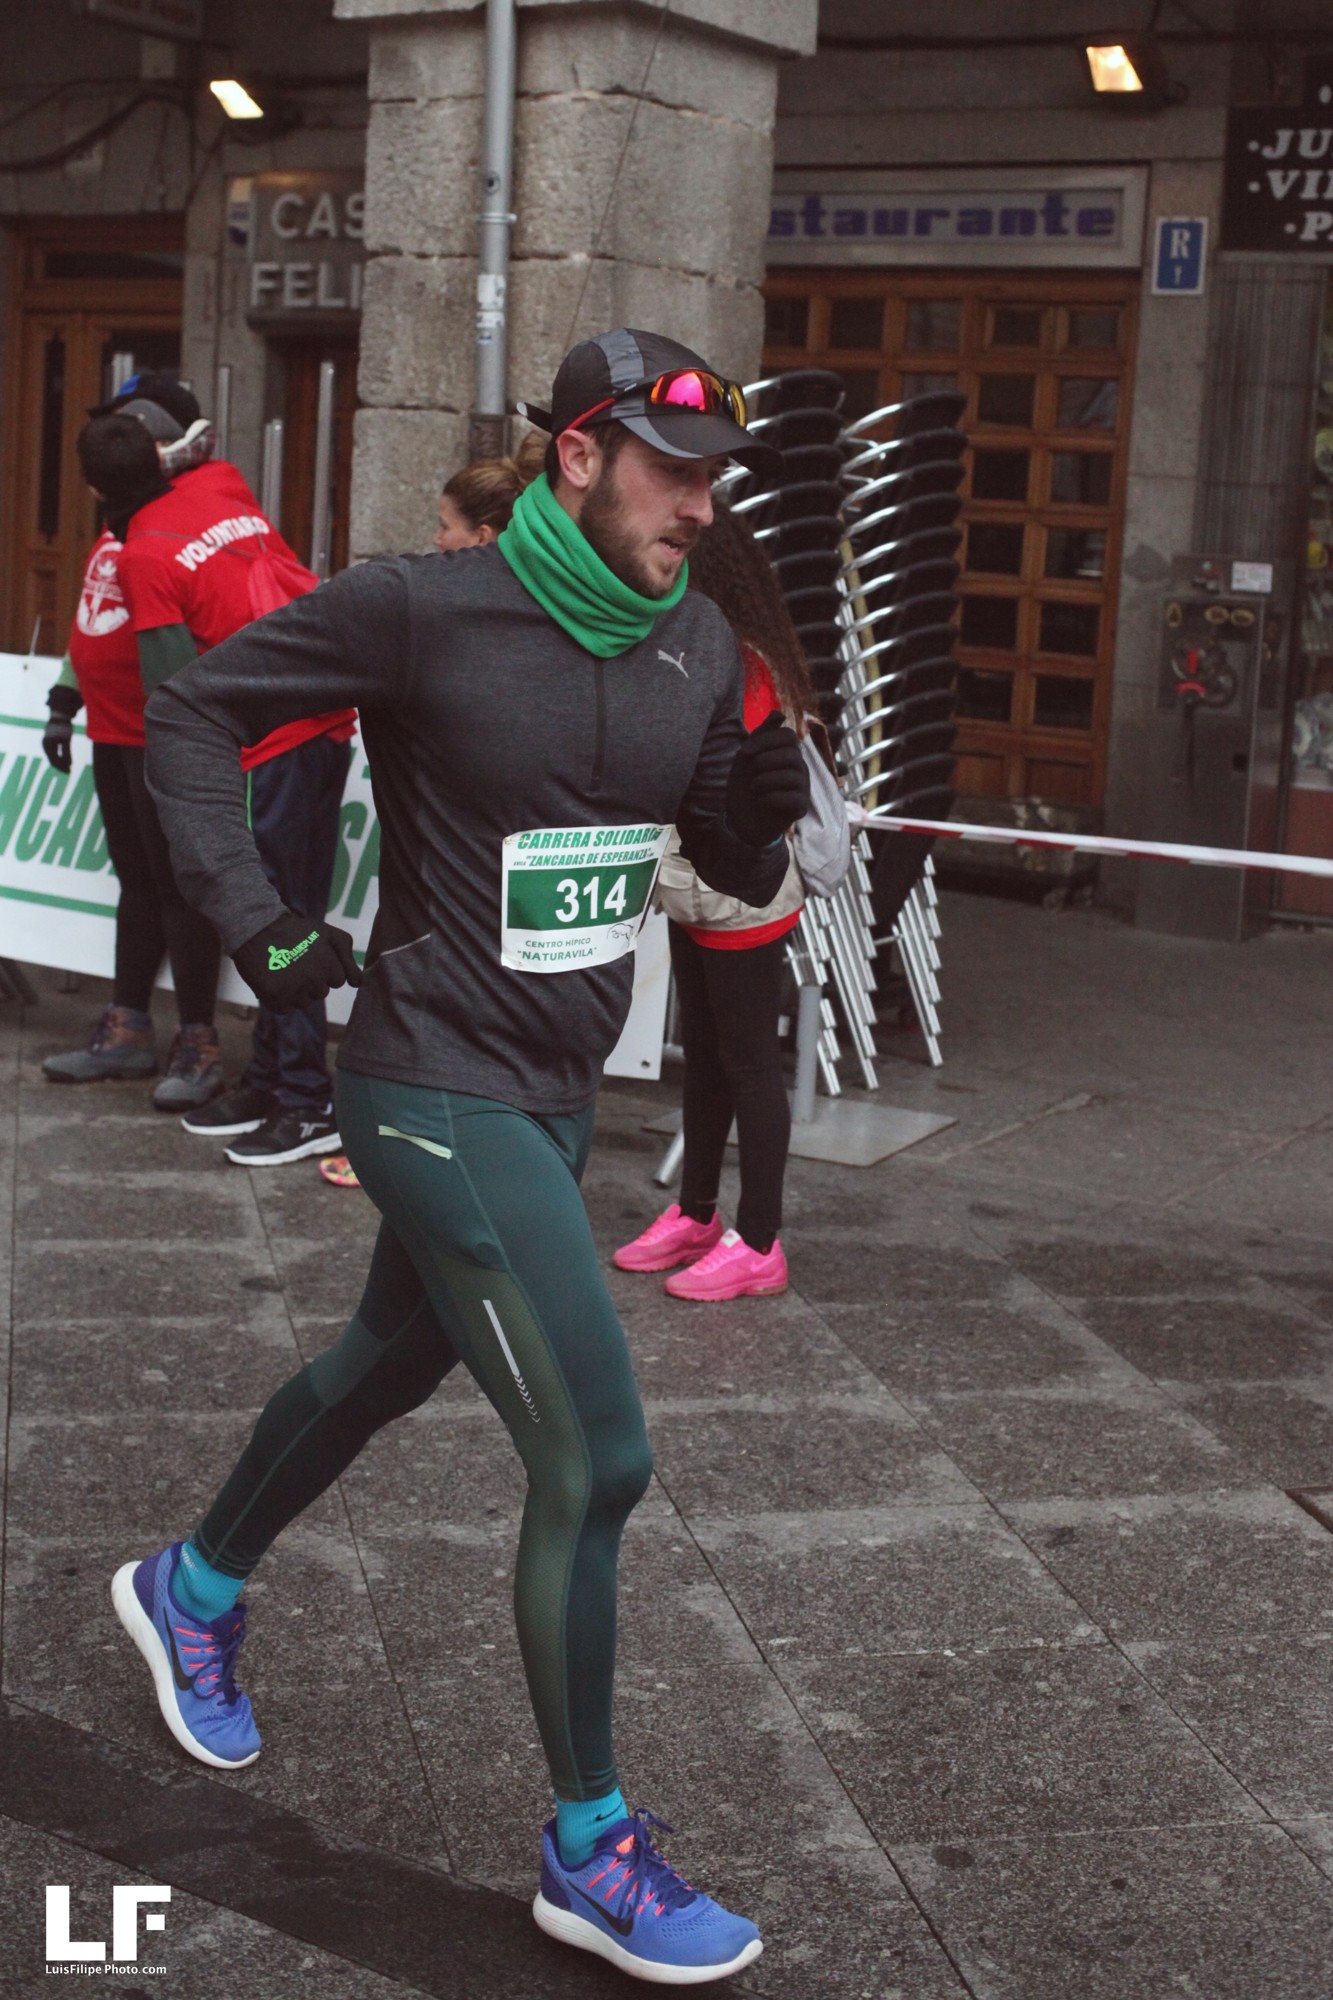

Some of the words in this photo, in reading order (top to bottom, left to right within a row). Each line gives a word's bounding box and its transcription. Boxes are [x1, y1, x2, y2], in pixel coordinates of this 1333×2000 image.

[768, 195, 1115, 236] staurante
[1300, 211, 1333, 241] P
[1169, 228, 1191, 259] R
[252, 261, 361, 308] FELI
[175, 516, 270, 572] VOLUNTARO
[517, 831, 591, 849] CARRERA
[586, 852, 600, 864] DE
[555, 874, 627, 923] 314
[517, 947, 597, 961] "NATURAVILA"
[525, 940, 563, 948] CENTRO
[565, 937, 591, 947] HÍPICO
